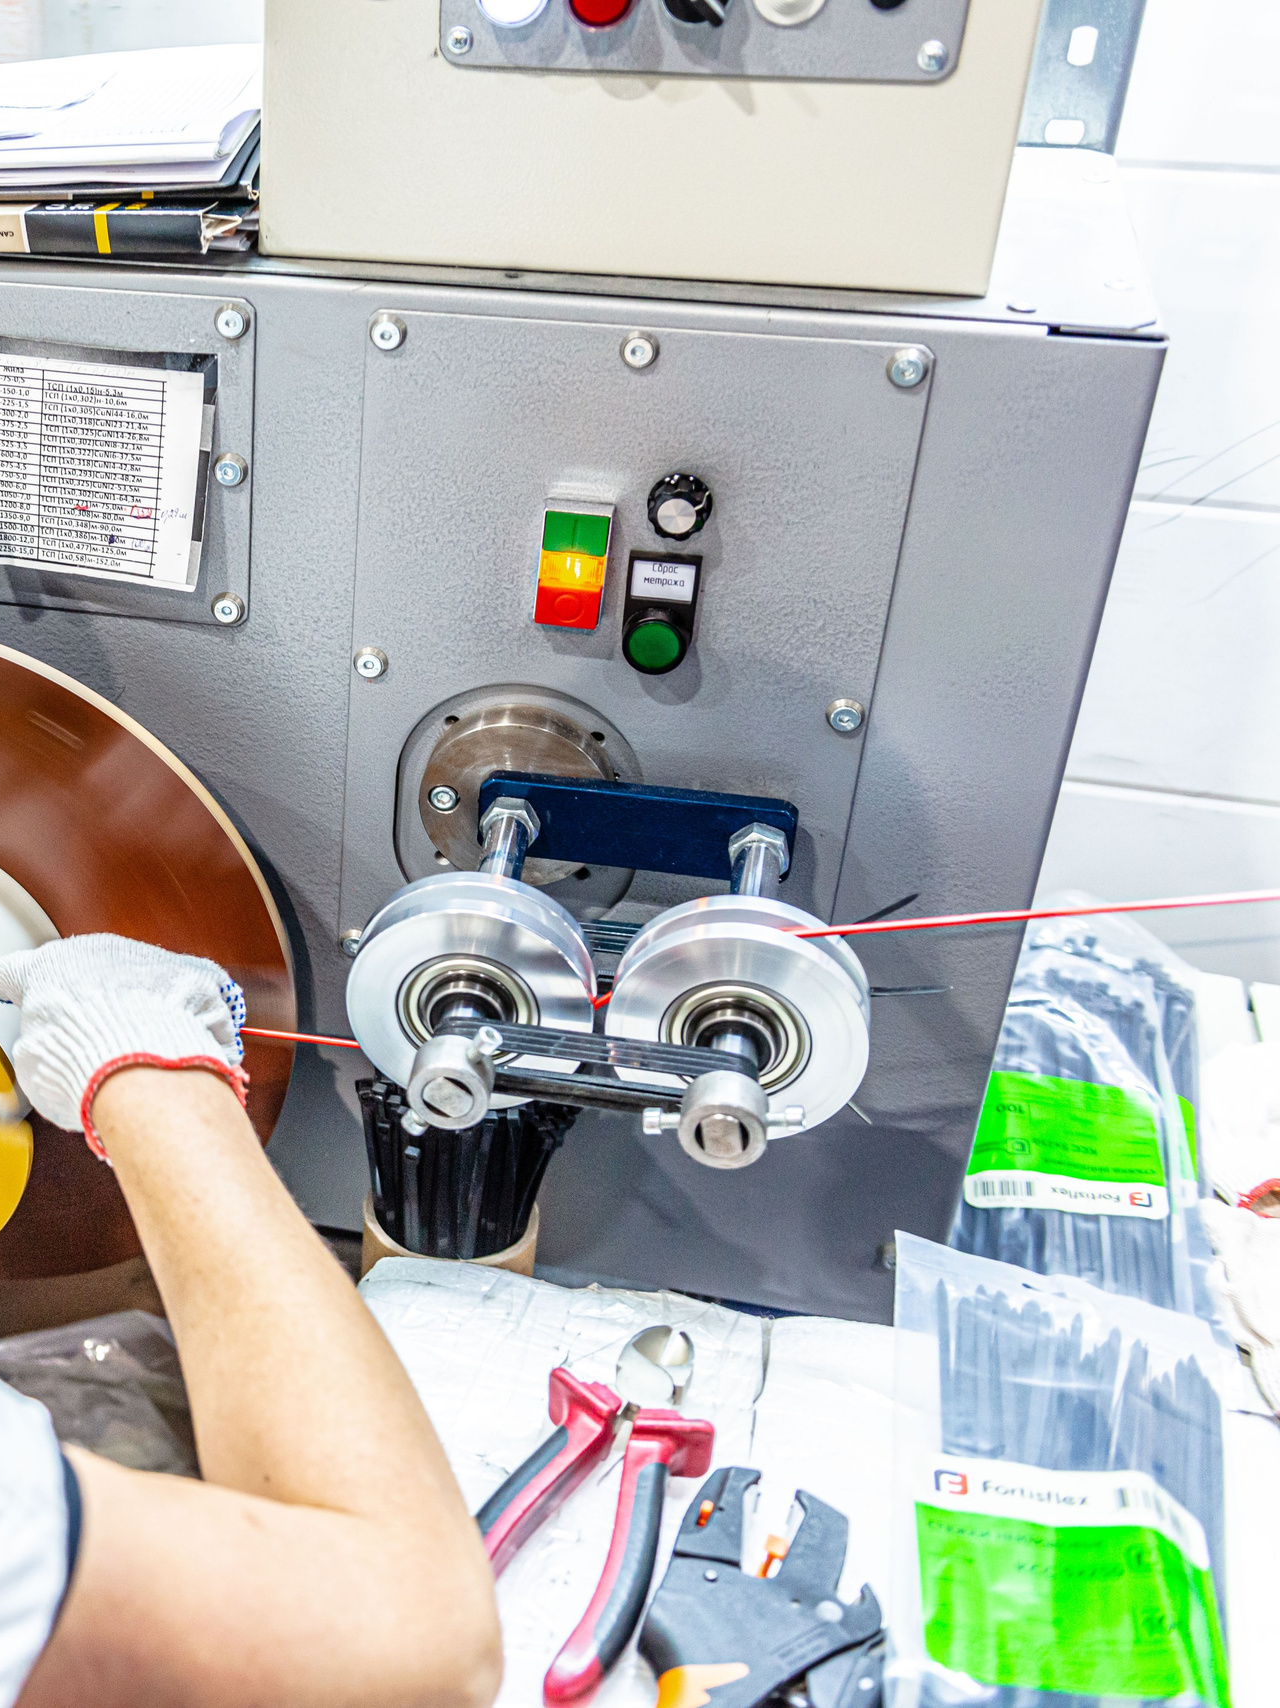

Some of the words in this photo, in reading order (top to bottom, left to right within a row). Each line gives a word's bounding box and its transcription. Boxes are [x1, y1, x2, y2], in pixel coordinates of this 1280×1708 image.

[44, 414, 58, 422] ТСП
[42, 550, 55, 558] ТСП
[652, 563, 678, 574] Сброс
[644, 577, 684, 587] метража
[1050, 1186, 1120, 1203] Fortisflex
[982, 1480, 1088, 1506] Fortisflex
